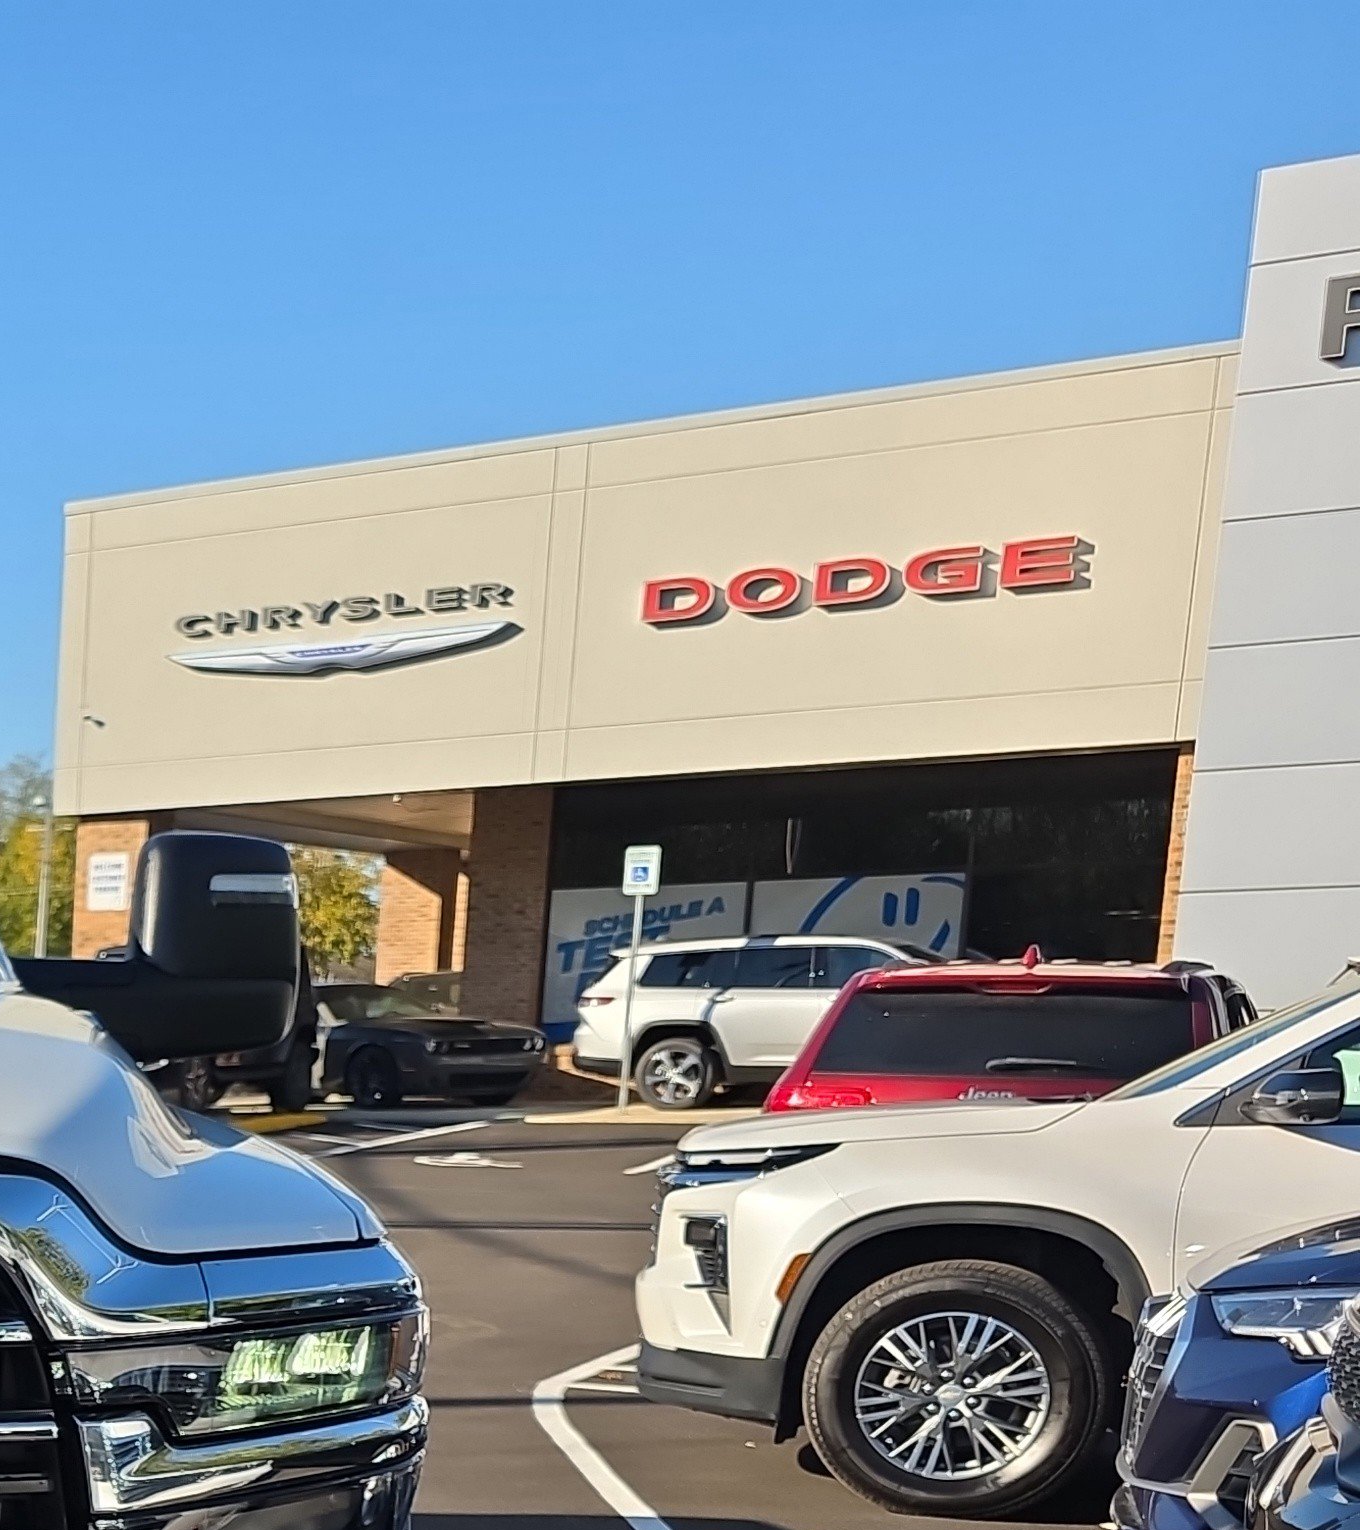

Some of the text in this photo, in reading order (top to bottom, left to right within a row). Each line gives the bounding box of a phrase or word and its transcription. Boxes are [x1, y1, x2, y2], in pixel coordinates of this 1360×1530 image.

[640, 534, 1088, 628] DODGE
[176, 582, 516, 639] CHRYSLER
[705, 896, 726, 916] A
